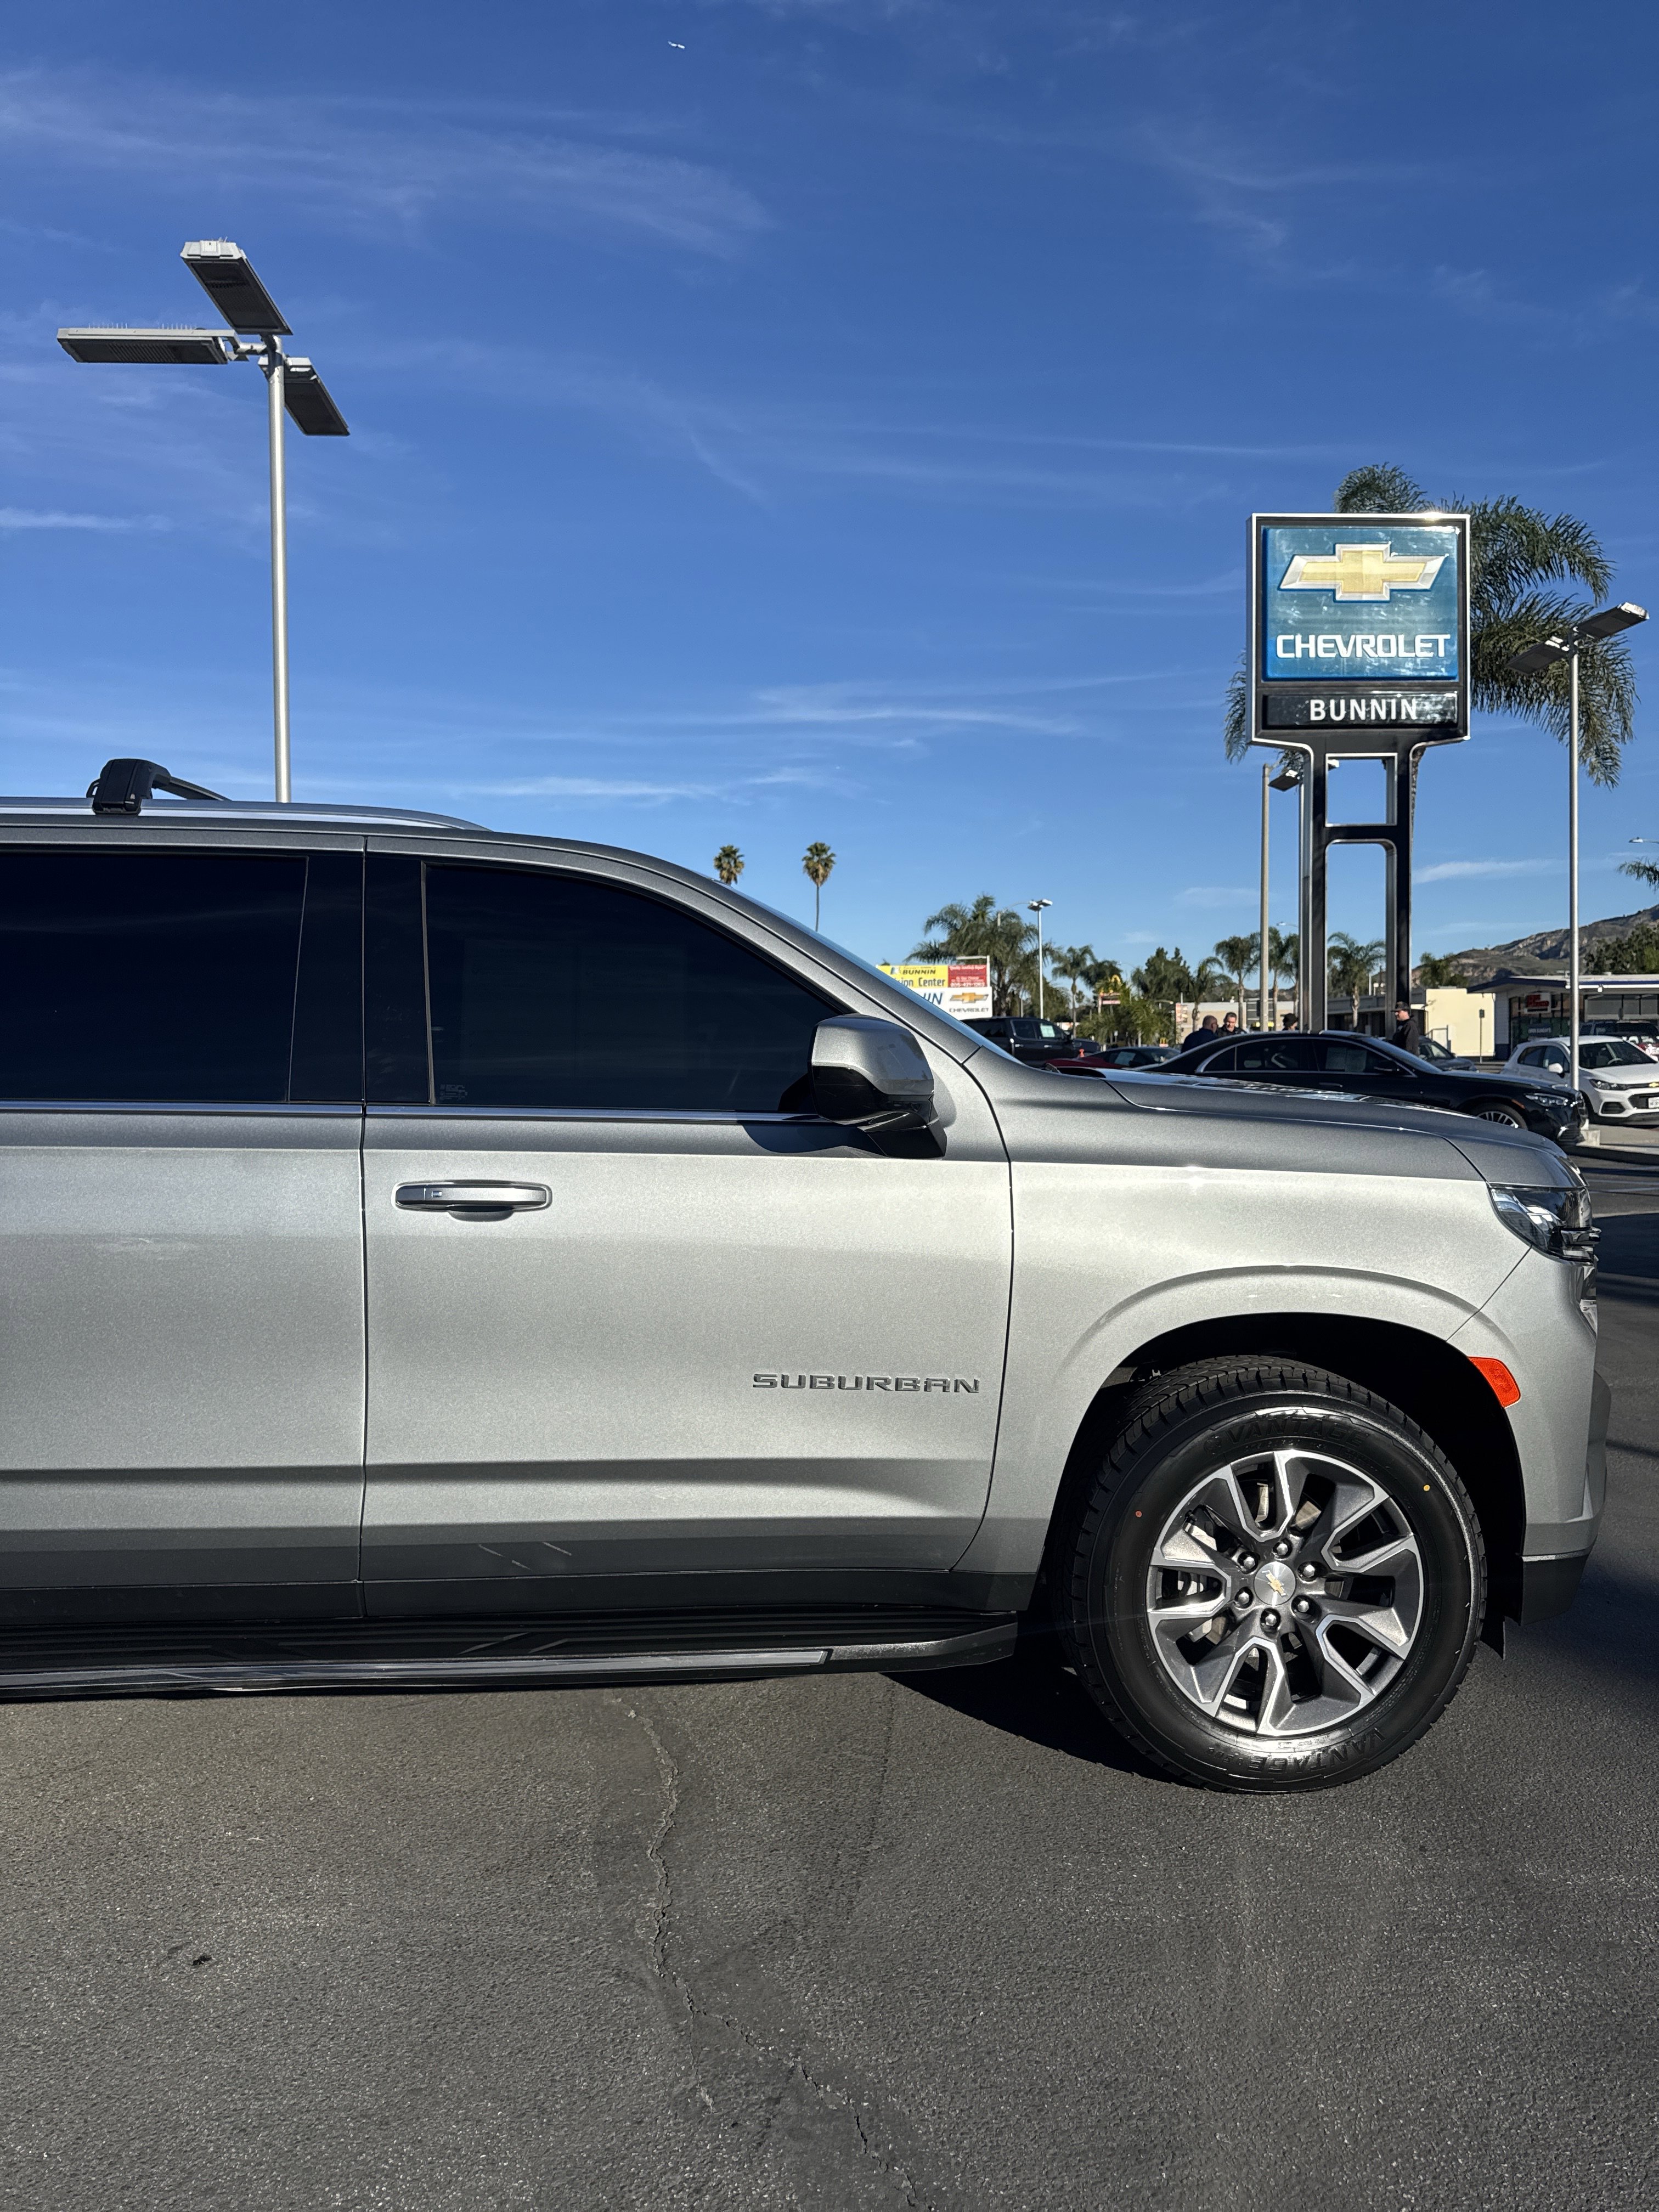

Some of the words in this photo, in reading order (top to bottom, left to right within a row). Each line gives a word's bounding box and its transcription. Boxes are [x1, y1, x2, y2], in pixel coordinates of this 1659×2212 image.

[1277, 634, 1451, 658] CHEVROLET
[1310, 699, 1418, 721] BUNNIN
[918, 977, 946, 987] Center
[753, 1374, 980, 1393] SUBURBAN
[1225, 1416, 1370, 1449] VANTAGE
[1246, 1727, 1387, 1774] VANTAGE
